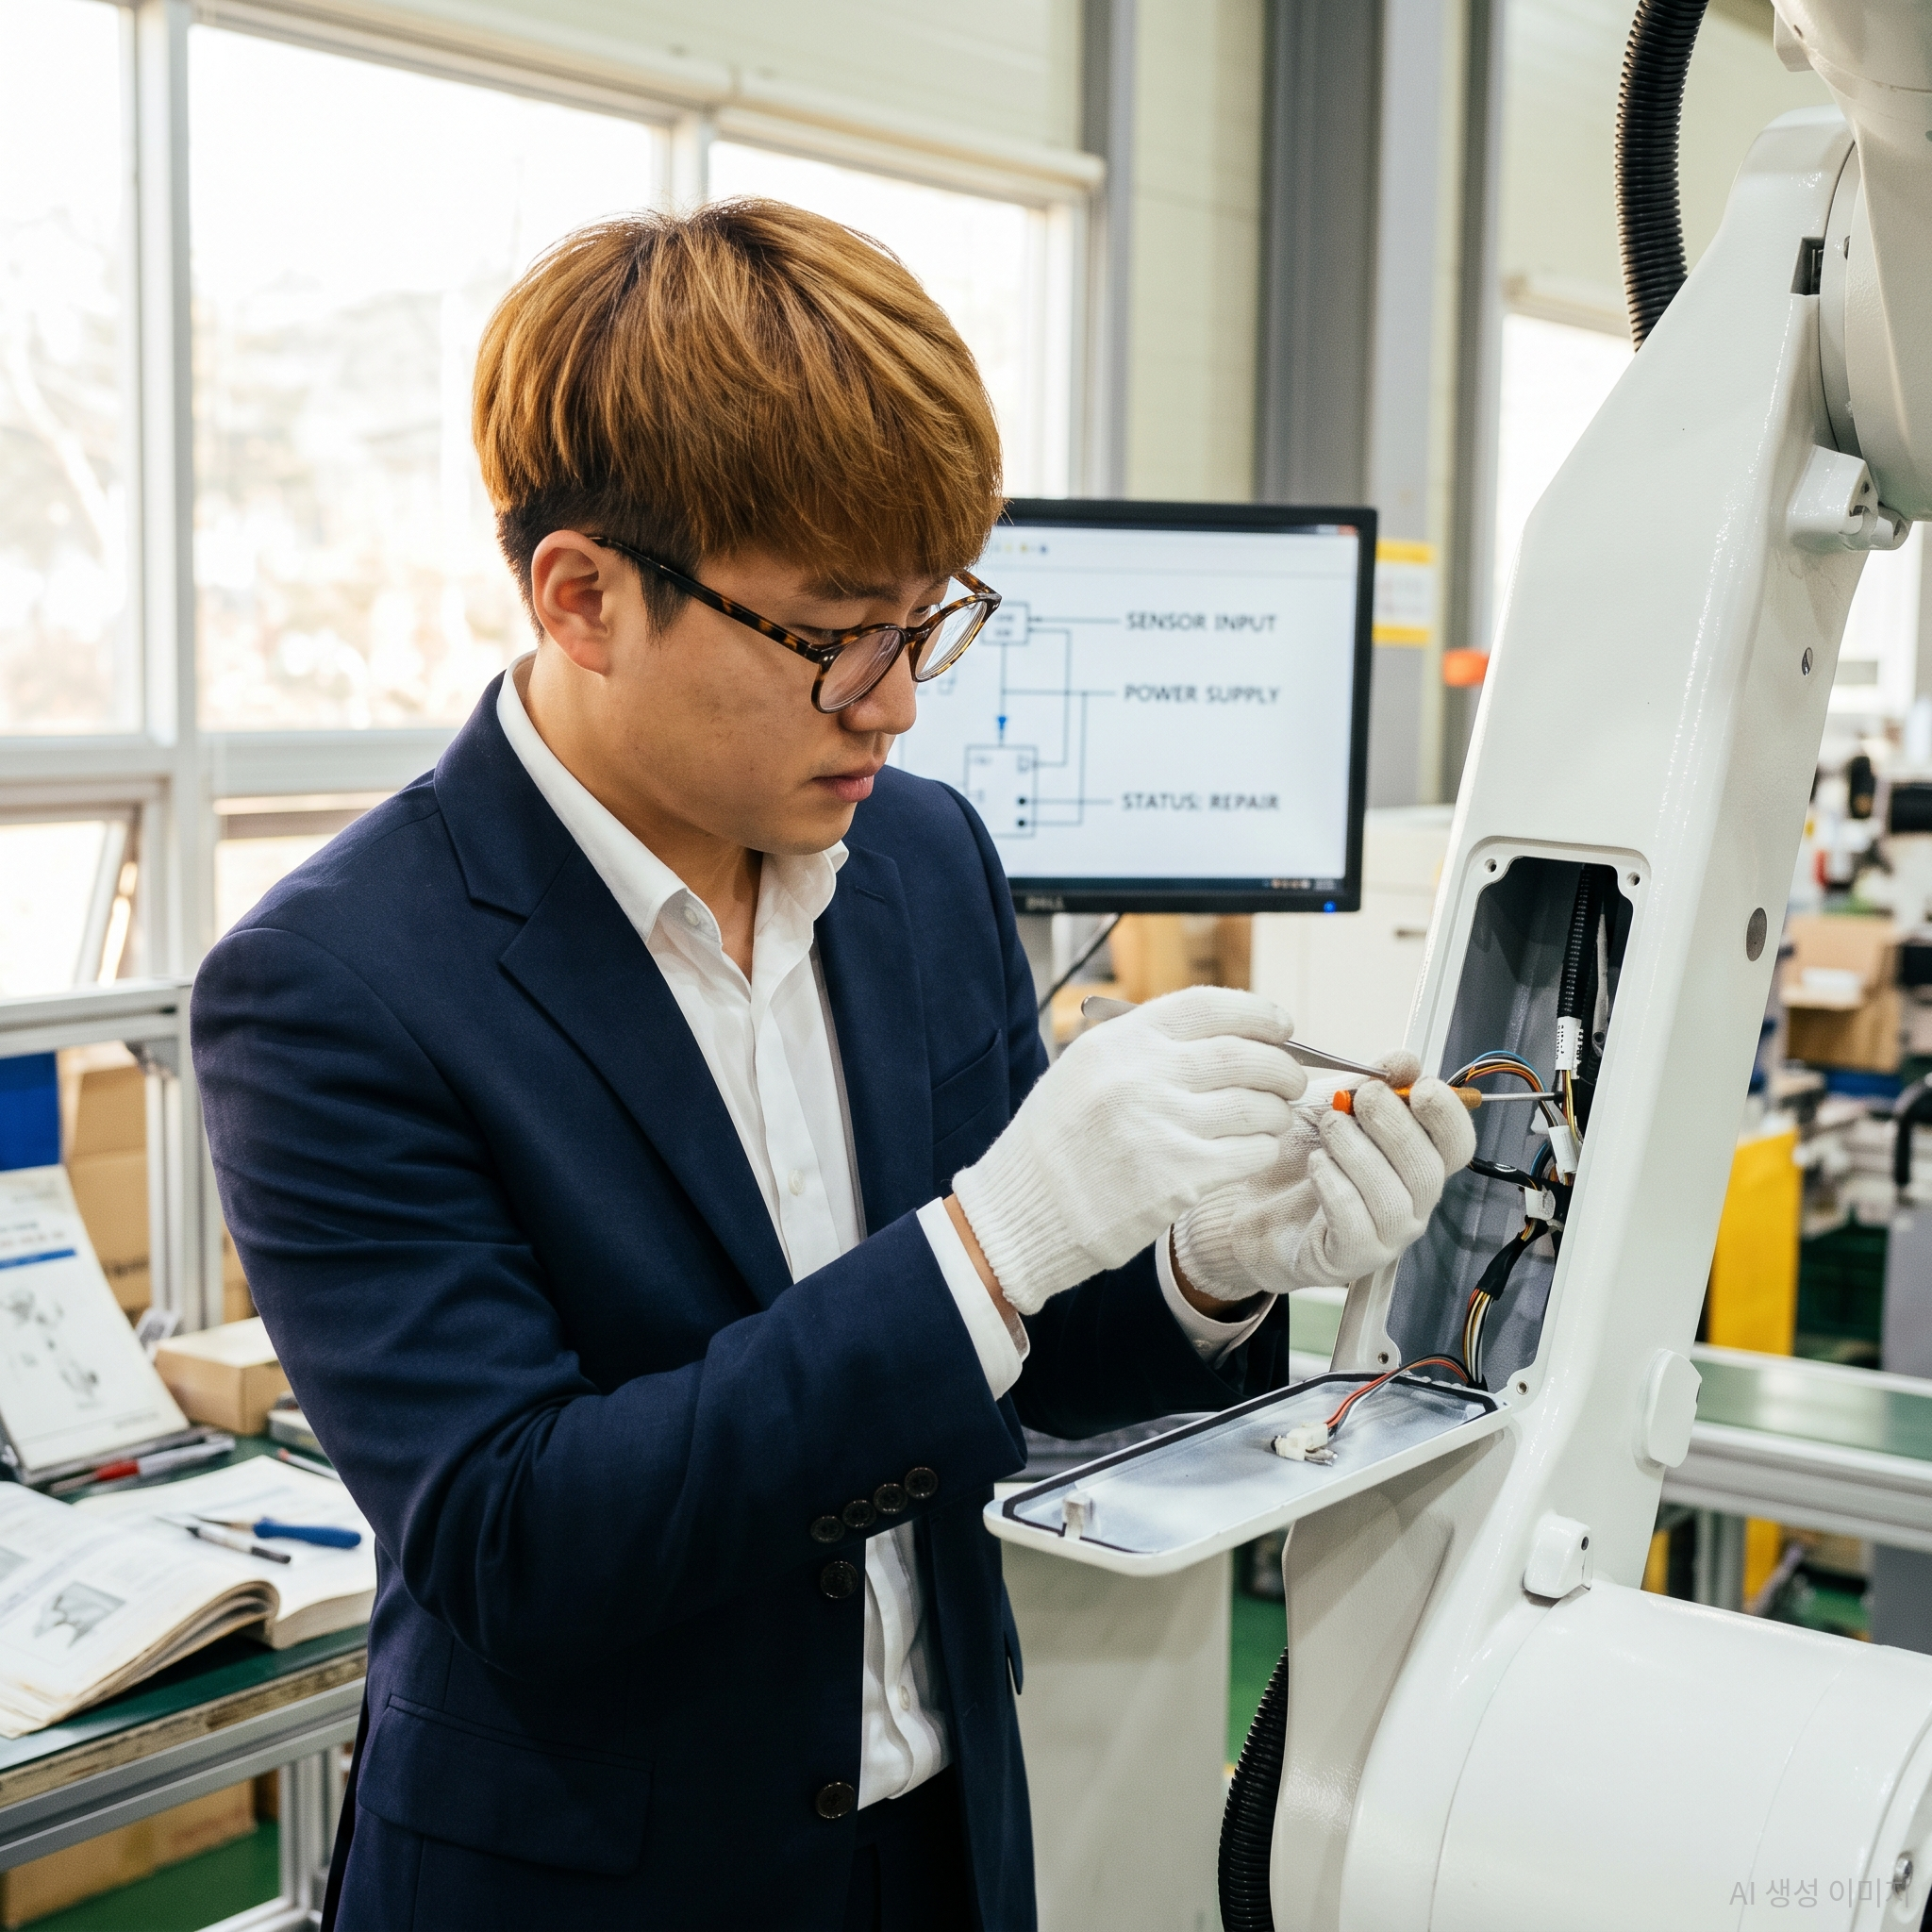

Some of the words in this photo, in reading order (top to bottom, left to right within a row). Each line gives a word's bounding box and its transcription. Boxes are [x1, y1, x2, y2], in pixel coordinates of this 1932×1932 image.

[1126, 612, 1206, 632] SENSOR
[1214, 613, 1276, 633] INPUT
[1124, 684, 1197, 703] POWER
[1206, 685, 1280, 705] SUPPLY
[1209, 793, 1279, 811] REPAIR
